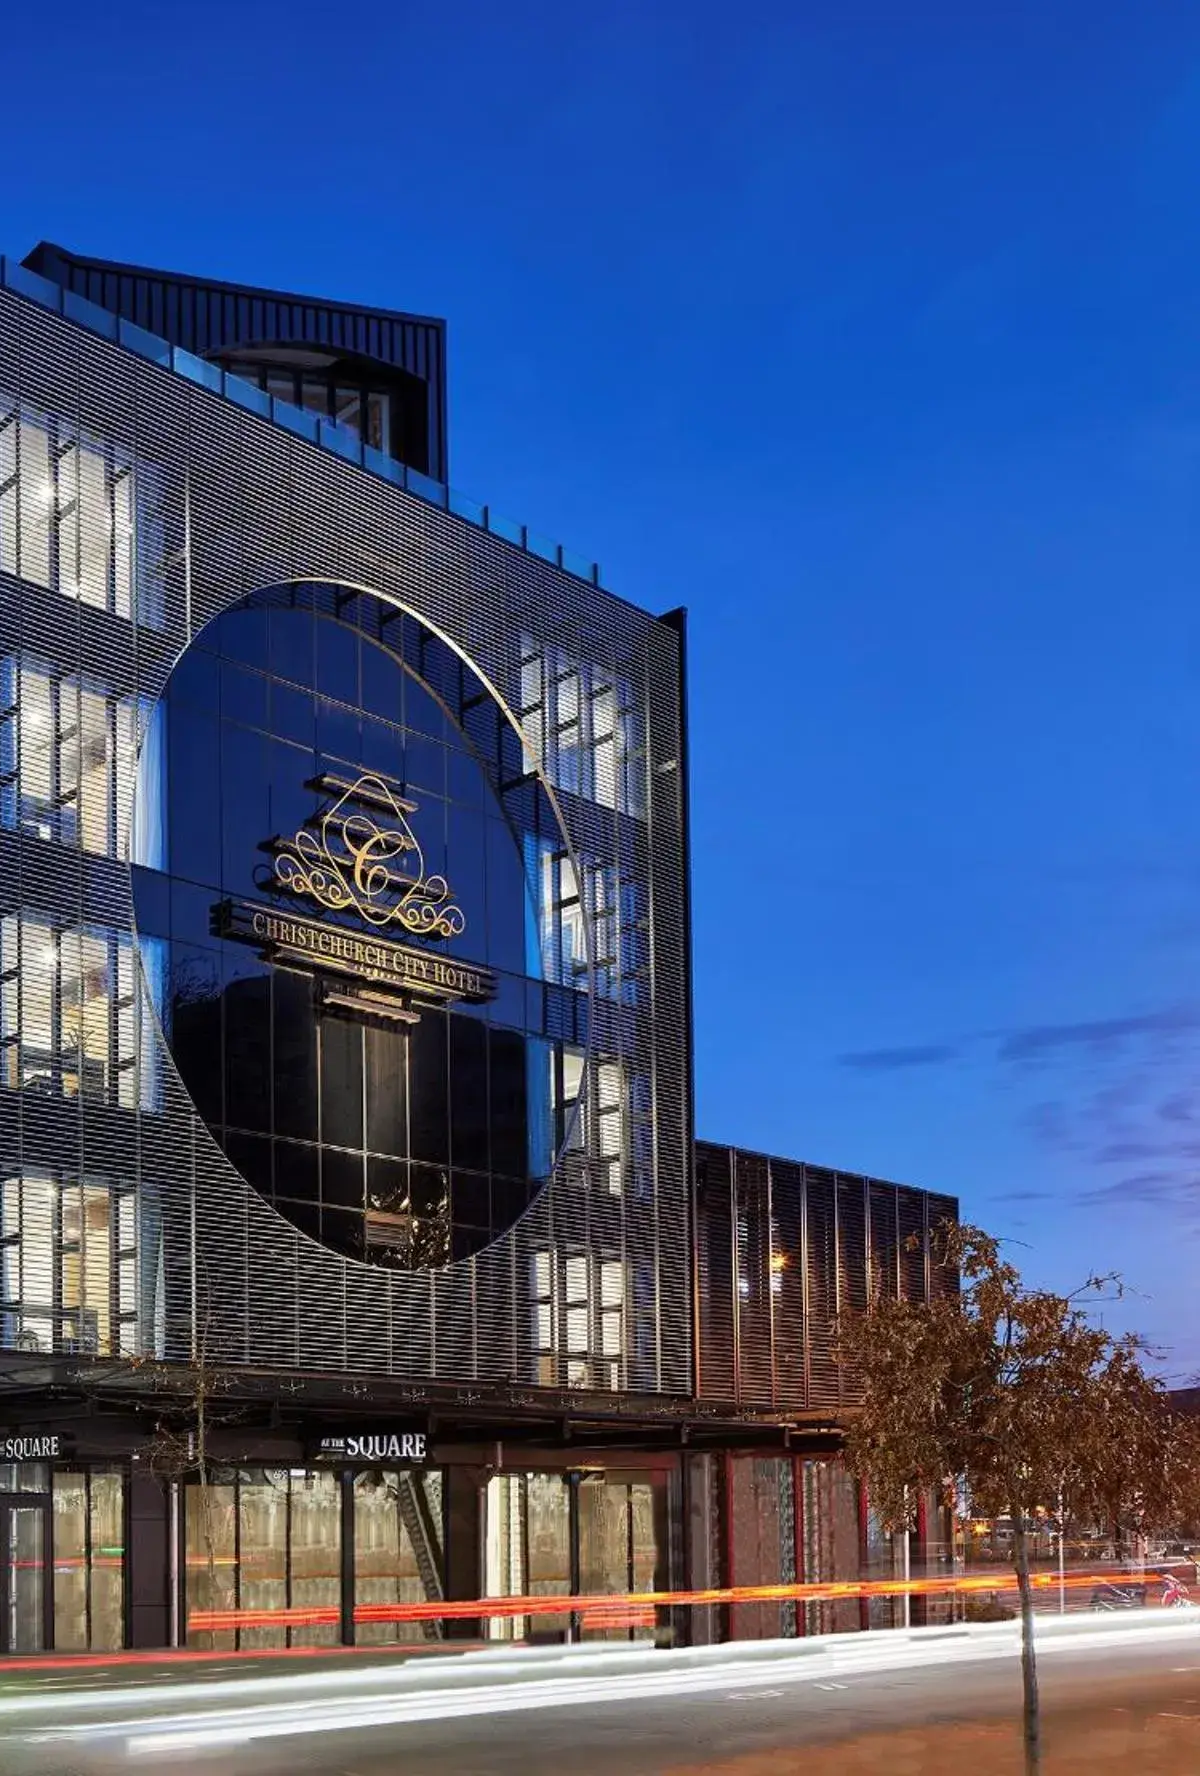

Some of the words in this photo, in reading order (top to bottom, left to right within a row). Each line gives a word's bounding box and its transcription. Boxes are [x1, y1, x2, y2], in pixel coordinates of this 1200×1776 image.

[252, 912, 387, 969] CHRISTCHURCH
[392, 950, 430, 981] CITY
[434, 961, 482, 993] HOTEL
[5, 1436, 60, 1460] SQUARE
[347, 1433, 426, 1460] SQUARE
